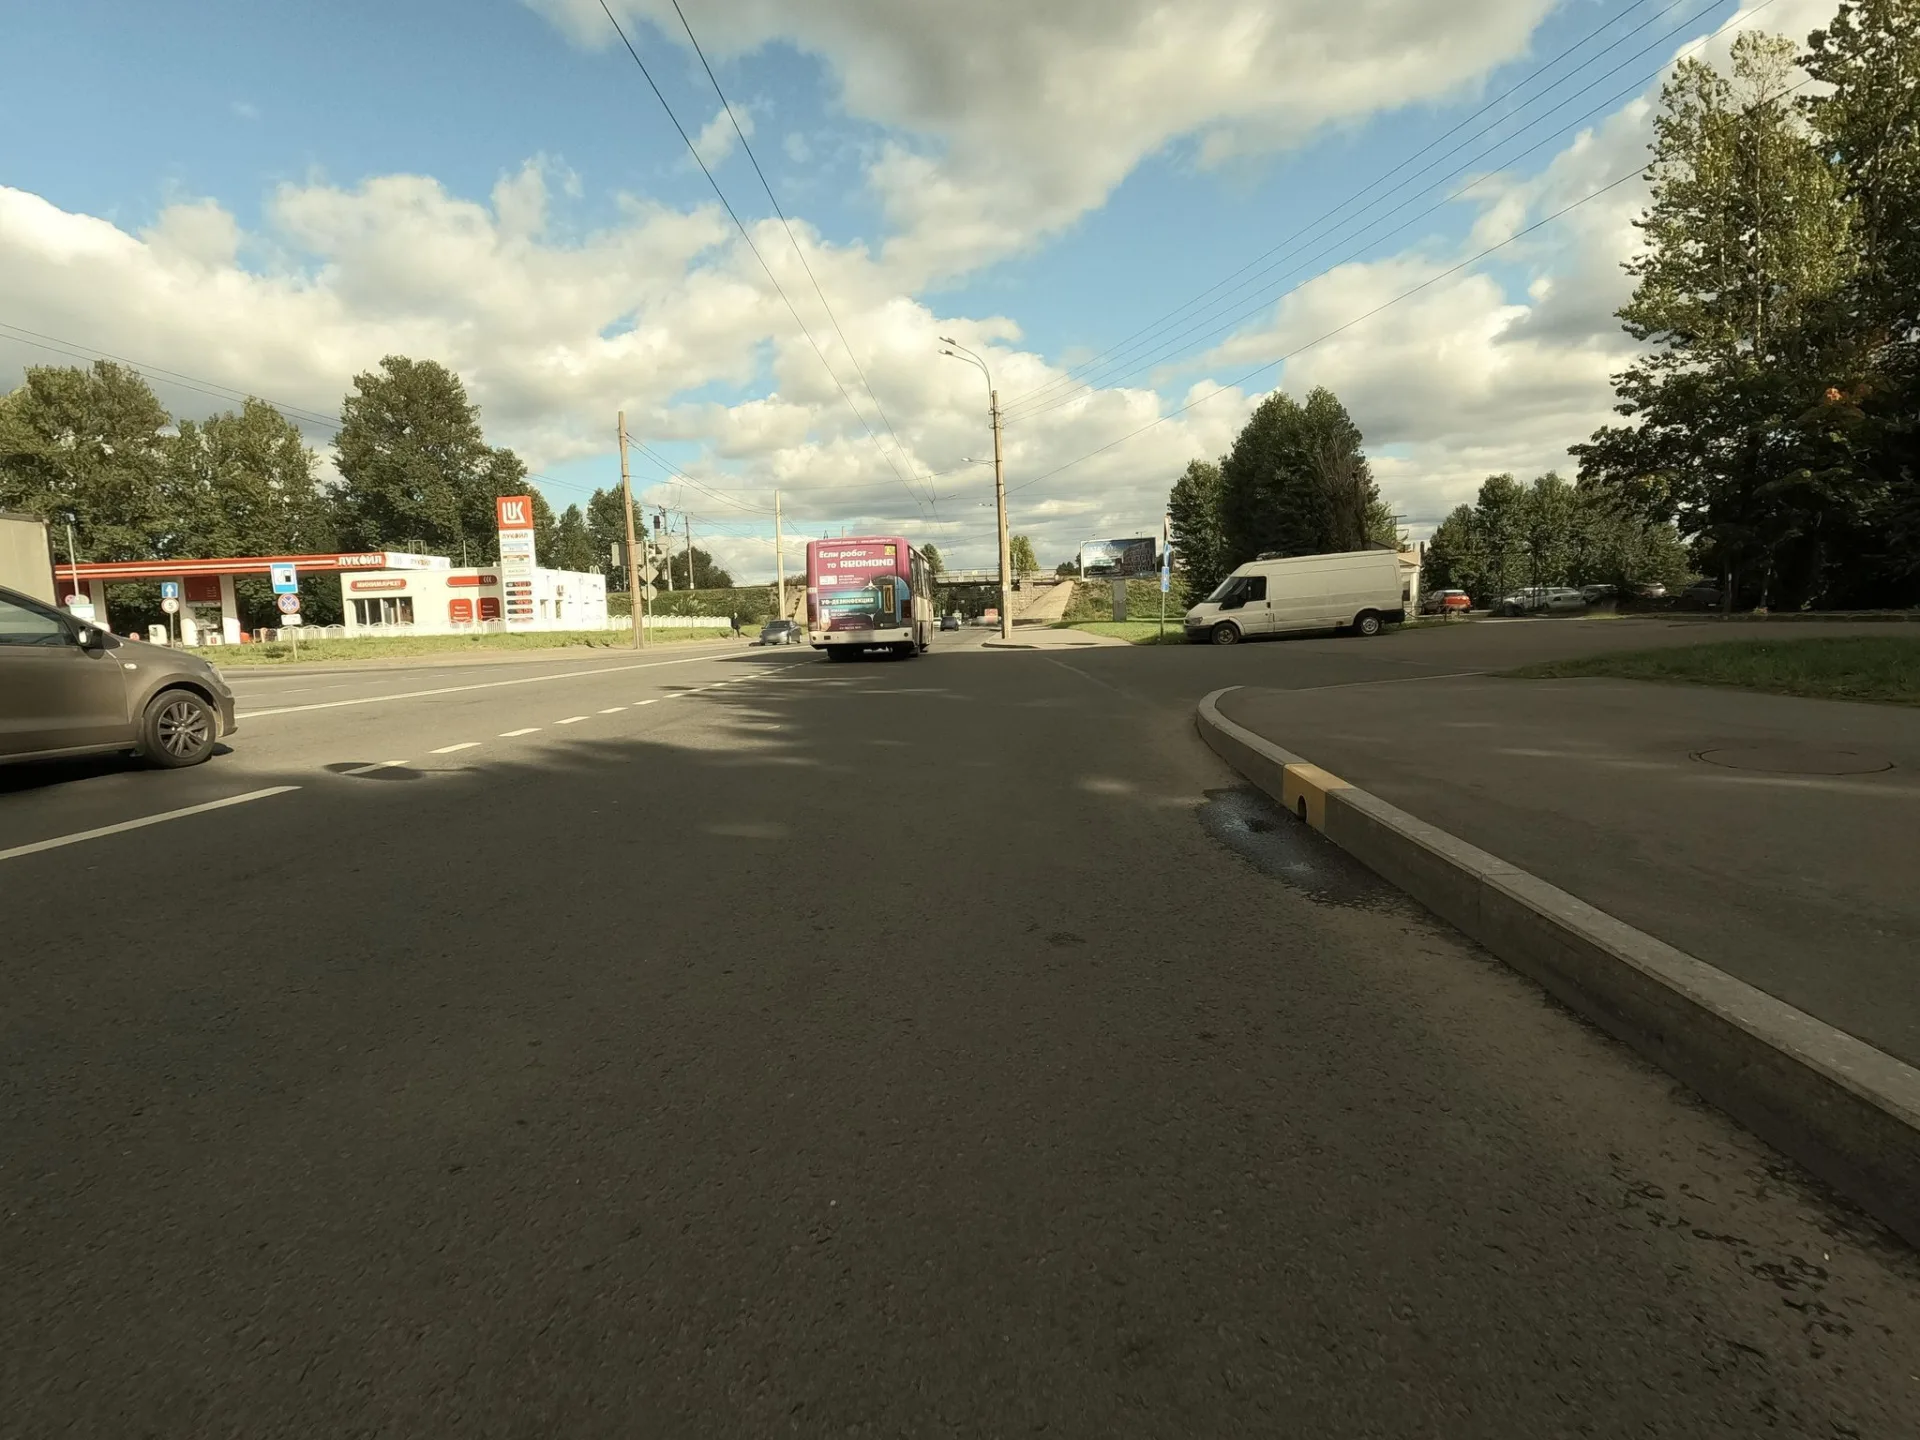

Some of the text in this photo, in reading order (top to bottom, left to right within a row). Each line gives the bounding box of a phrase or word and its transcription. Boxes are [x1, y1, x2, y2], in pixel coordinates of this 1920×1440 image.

[819, 550, 839, 558] Если
[840, 549, 867, 559] робот
[338, 554, 382, 567] ЛУКОЙЛ
[840, 558, 894, 568] REDMOND
